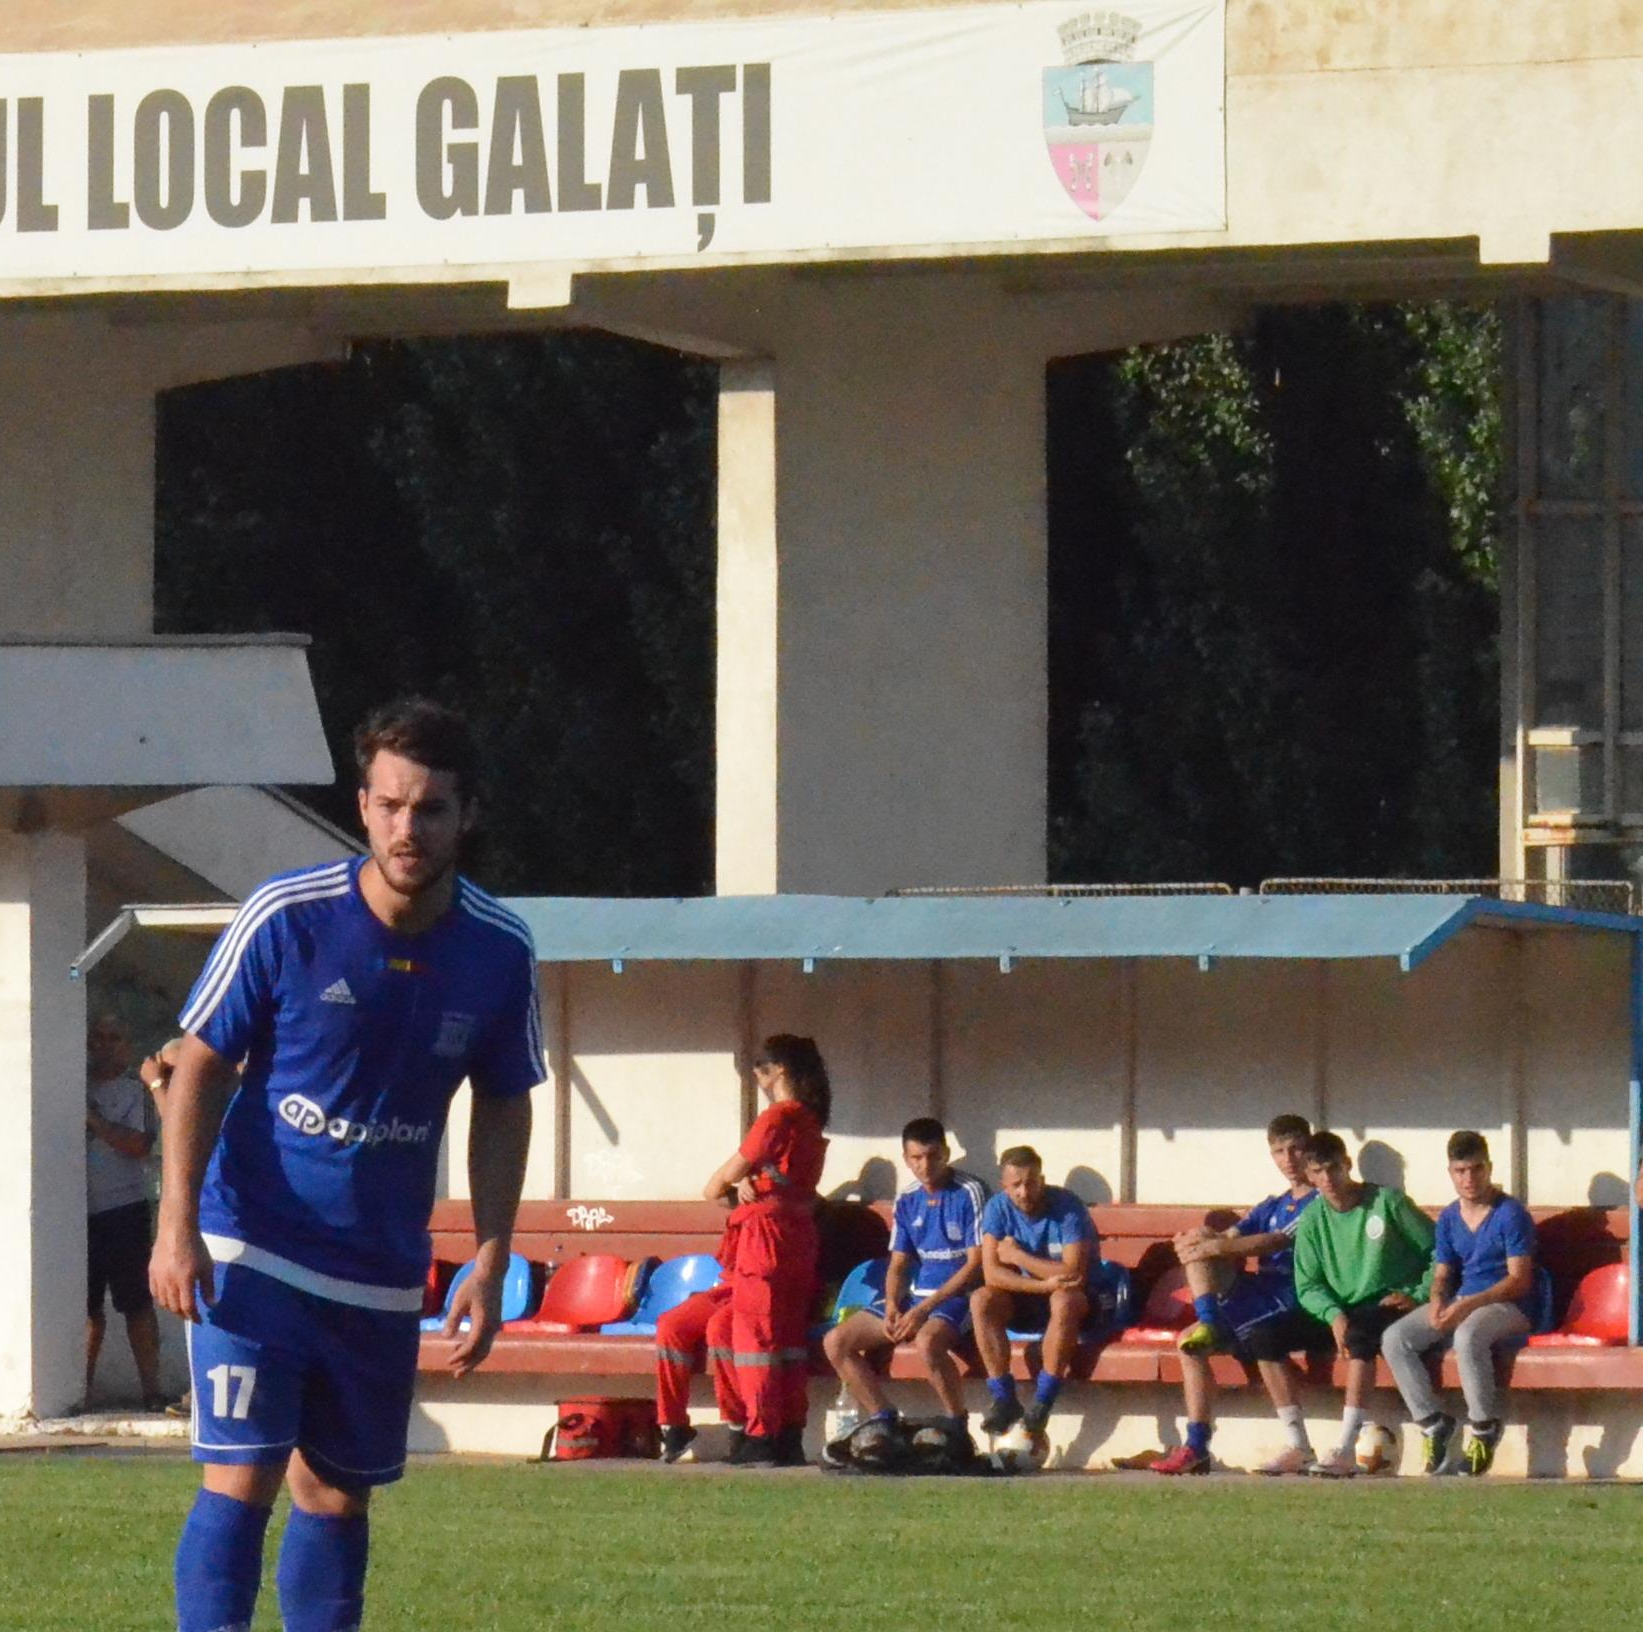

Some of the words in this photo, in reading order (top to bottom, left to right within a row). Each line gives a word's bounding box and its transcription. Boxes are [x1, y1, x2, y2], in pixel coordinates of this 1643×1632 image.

[87, 83, 387, 231] LOCAL
[415, 62, 772, 252] GALAȚI
[207, 1364, 256, 1419] 17
